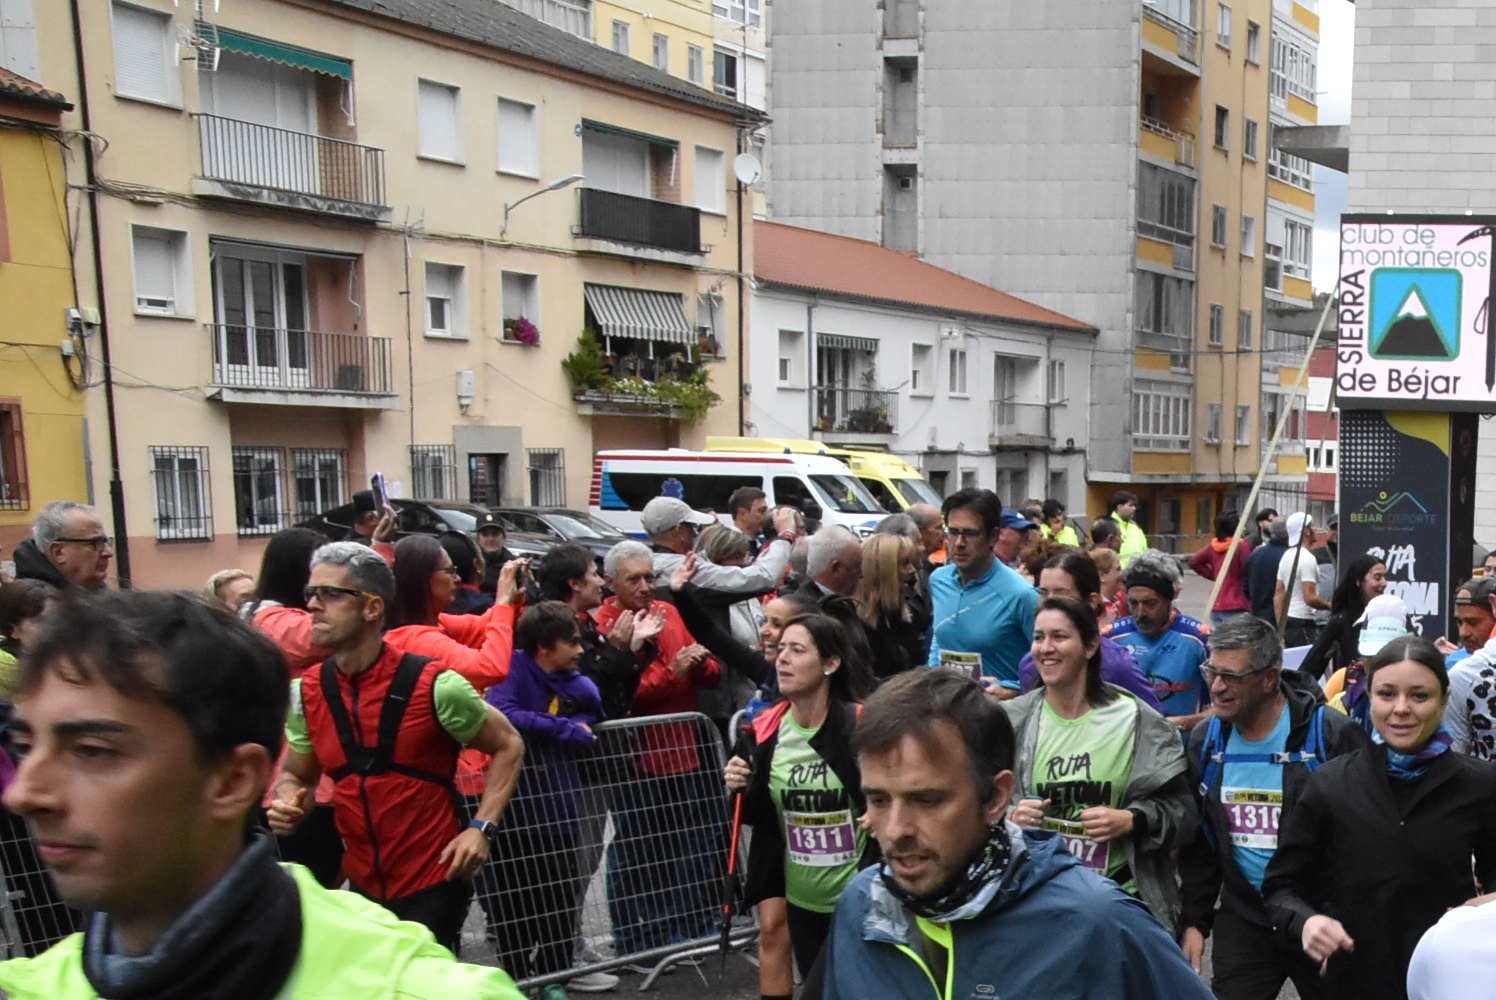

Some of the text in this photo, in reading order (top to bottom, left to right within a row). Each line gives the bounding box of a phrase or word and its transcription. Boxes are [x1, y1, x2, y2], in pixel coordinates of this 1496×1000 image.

[1341, 224, 1436, 245] club de
[1341, 246, 1488, 268] montañeros
[1338, 268, 1366, 365] SIERRA
[1338, 366, 1462, 399] de Béjar
[788, 760, 828, 788] RUTA
[1046, 752, 1092, 780] RUTA
[1036, 780, 1112, 807] VETONA
[1231, 804, 1281, 830] 1310
[792, 826, 843, 849] 1311
[1062, 838, 1099, 862] 07
